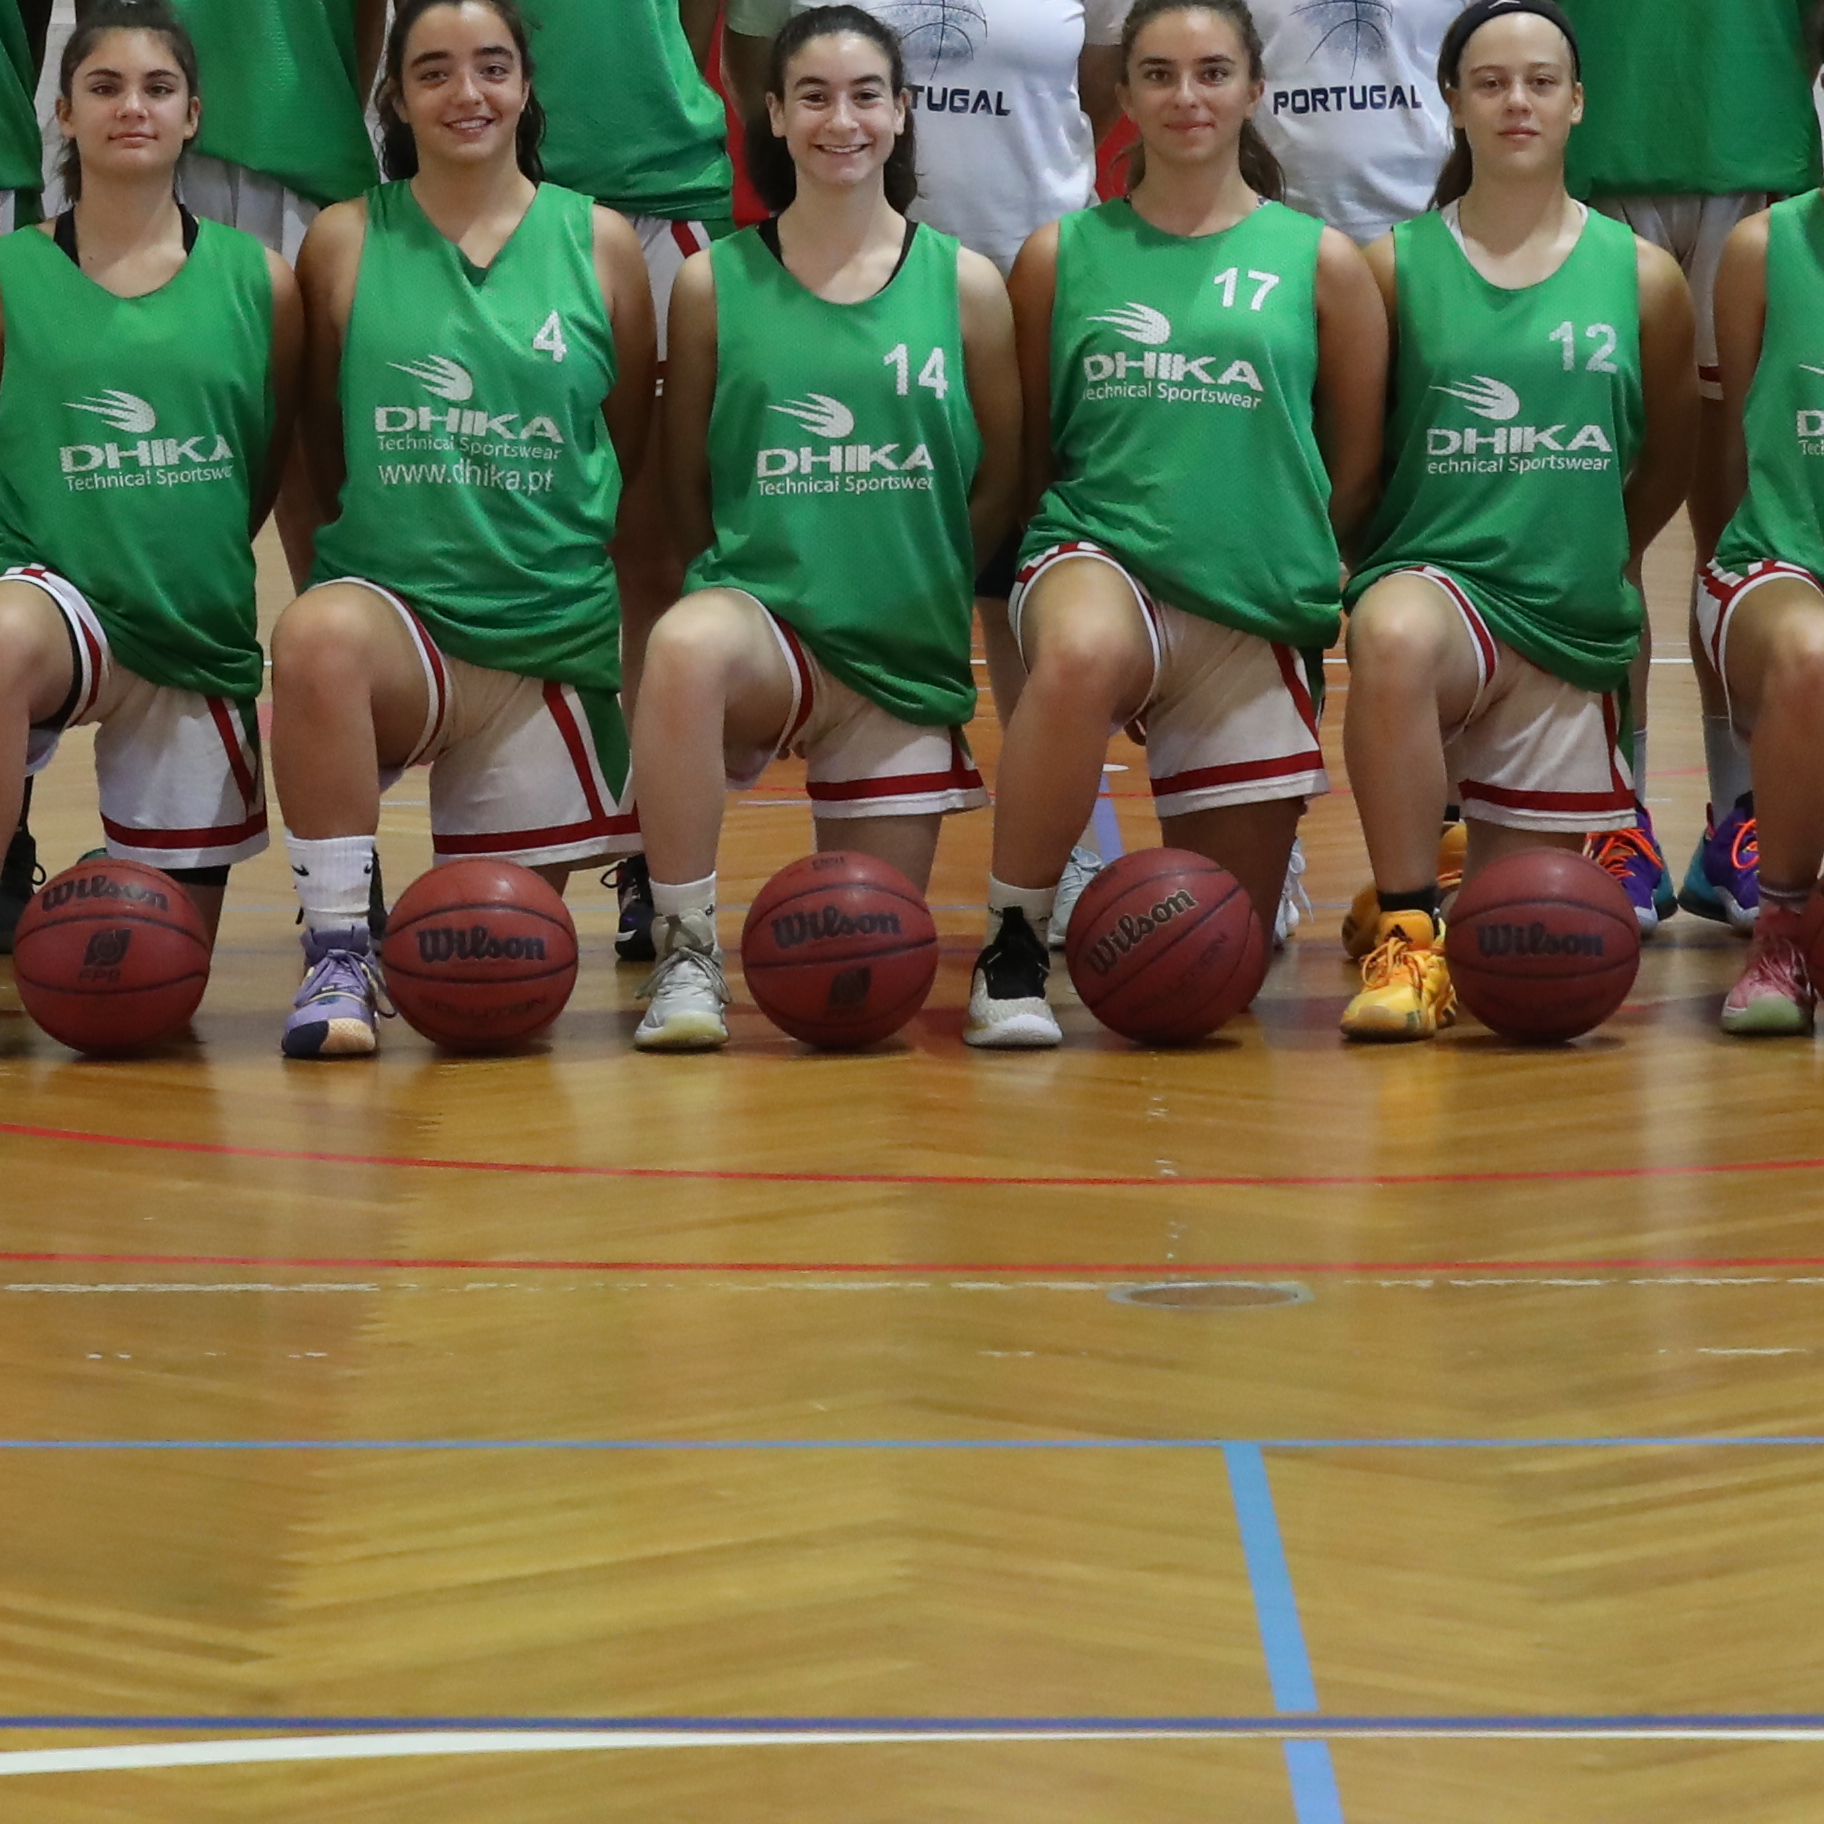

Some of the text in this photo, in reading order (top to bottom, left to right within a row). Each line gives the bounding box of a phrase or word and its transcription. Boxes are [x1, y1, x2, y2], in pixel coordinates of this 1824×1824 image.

[1273, 84, 1423, 116] PORTUGAL
[1213, 267, 1280, 311] 17
[532, 309, 567, 363] 4
[1548, 321, 1618, 374] 12
[883, 343, 949, 399] 14
[1083, 351, 1264, 392] DHIKA
[1157, 382, 1262, 409] Sportswear
[375, 406, 566, 444] DHIKA
[1426, 424, 1613, 456] DHIKA
[377, 435, 563, 460] Technical Sportswear
[756, 443, 934, 478] DHIKA
[1427, 454, 1611, 475] echnical Sportswear
[64, 469, 151, 491] Technical
[378, 457, 554, 496] www.dhika.pt
[757, 476, 839, 496] Technical
[42, 875, 169, 912] Wilson
[417, 925, 546, 963] Wilson
[771, 905, 903, 949] Wilson
[1087, 889, 1199, 976] Wilson
[1478, 921, 1605, 958] Wilson
